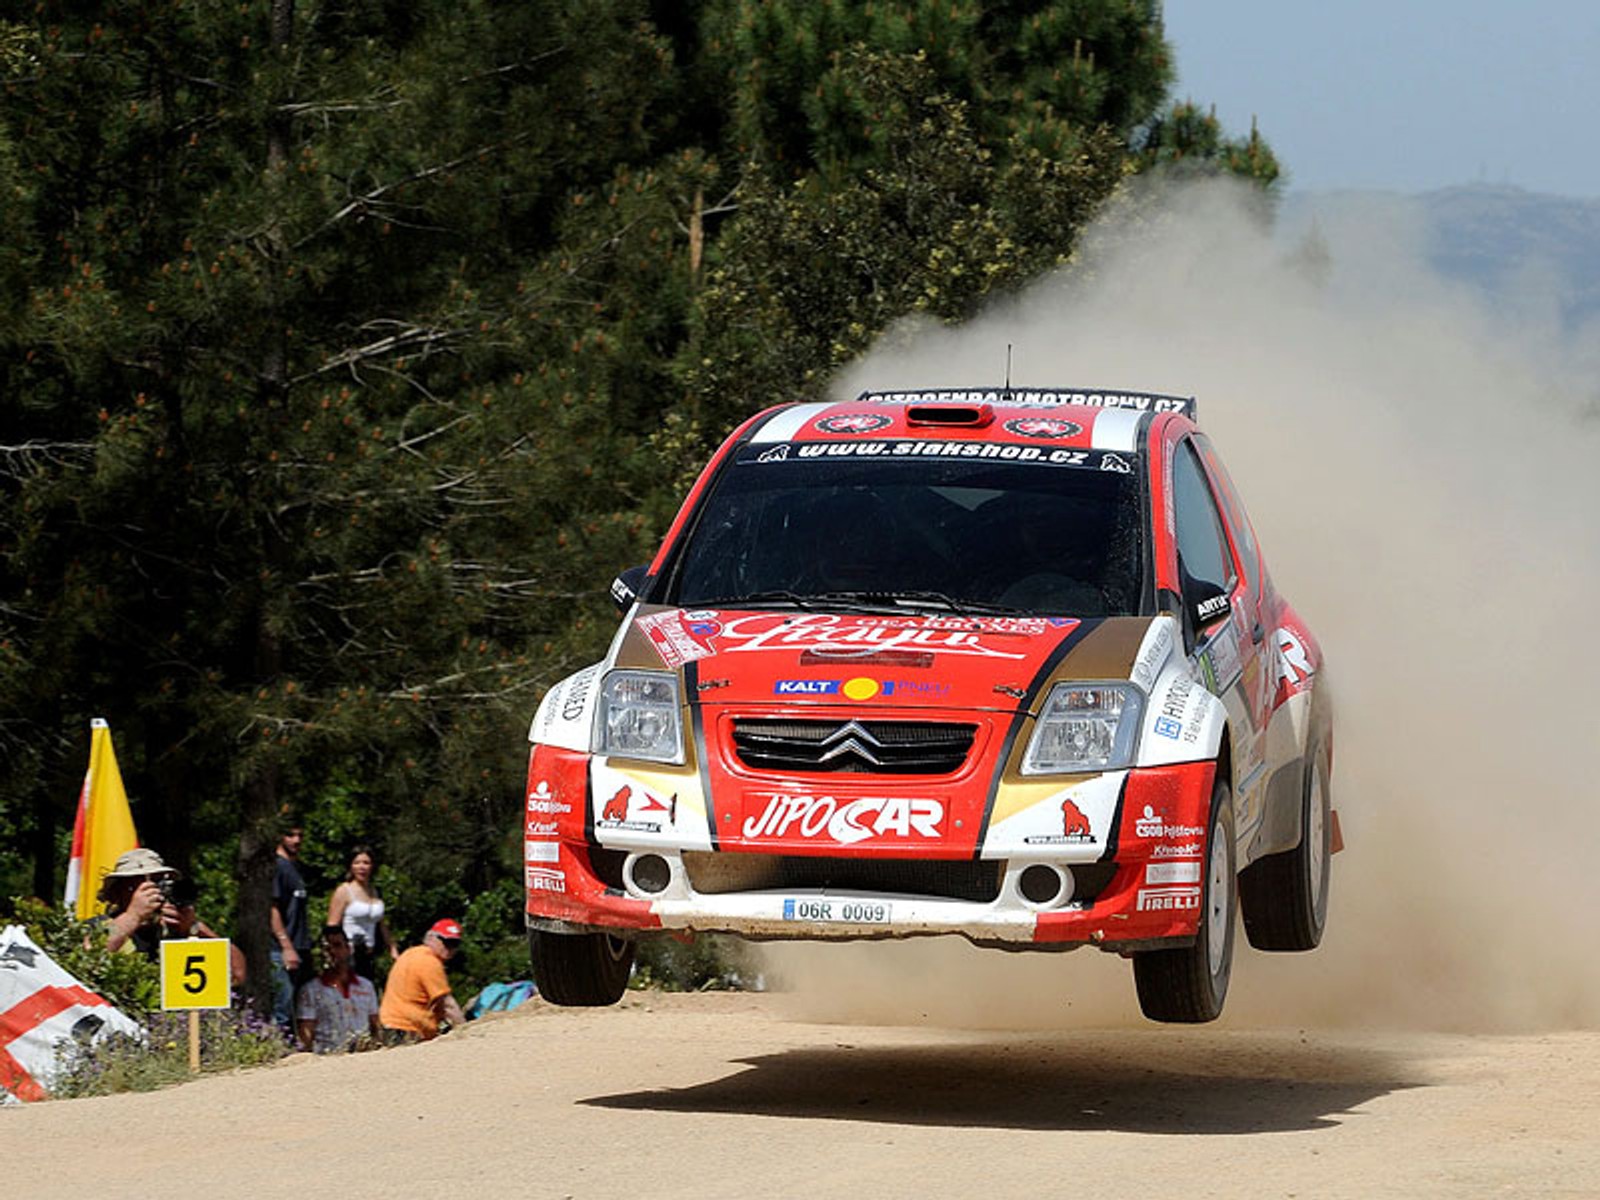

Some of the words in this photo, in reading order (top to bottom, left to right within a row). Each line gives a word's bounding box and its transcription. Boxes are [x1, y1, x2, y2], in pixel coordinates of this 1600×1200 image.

[779, 681, 832, 693] KALT
[743, 794, 944, 844] JIPOCAR
[1136, 887, 1200, 911] PIRELLI
[799, 902, 832, 919] 06R
[842, 904, 885, 921] 0009
[182, 955, 207, 994] 5
